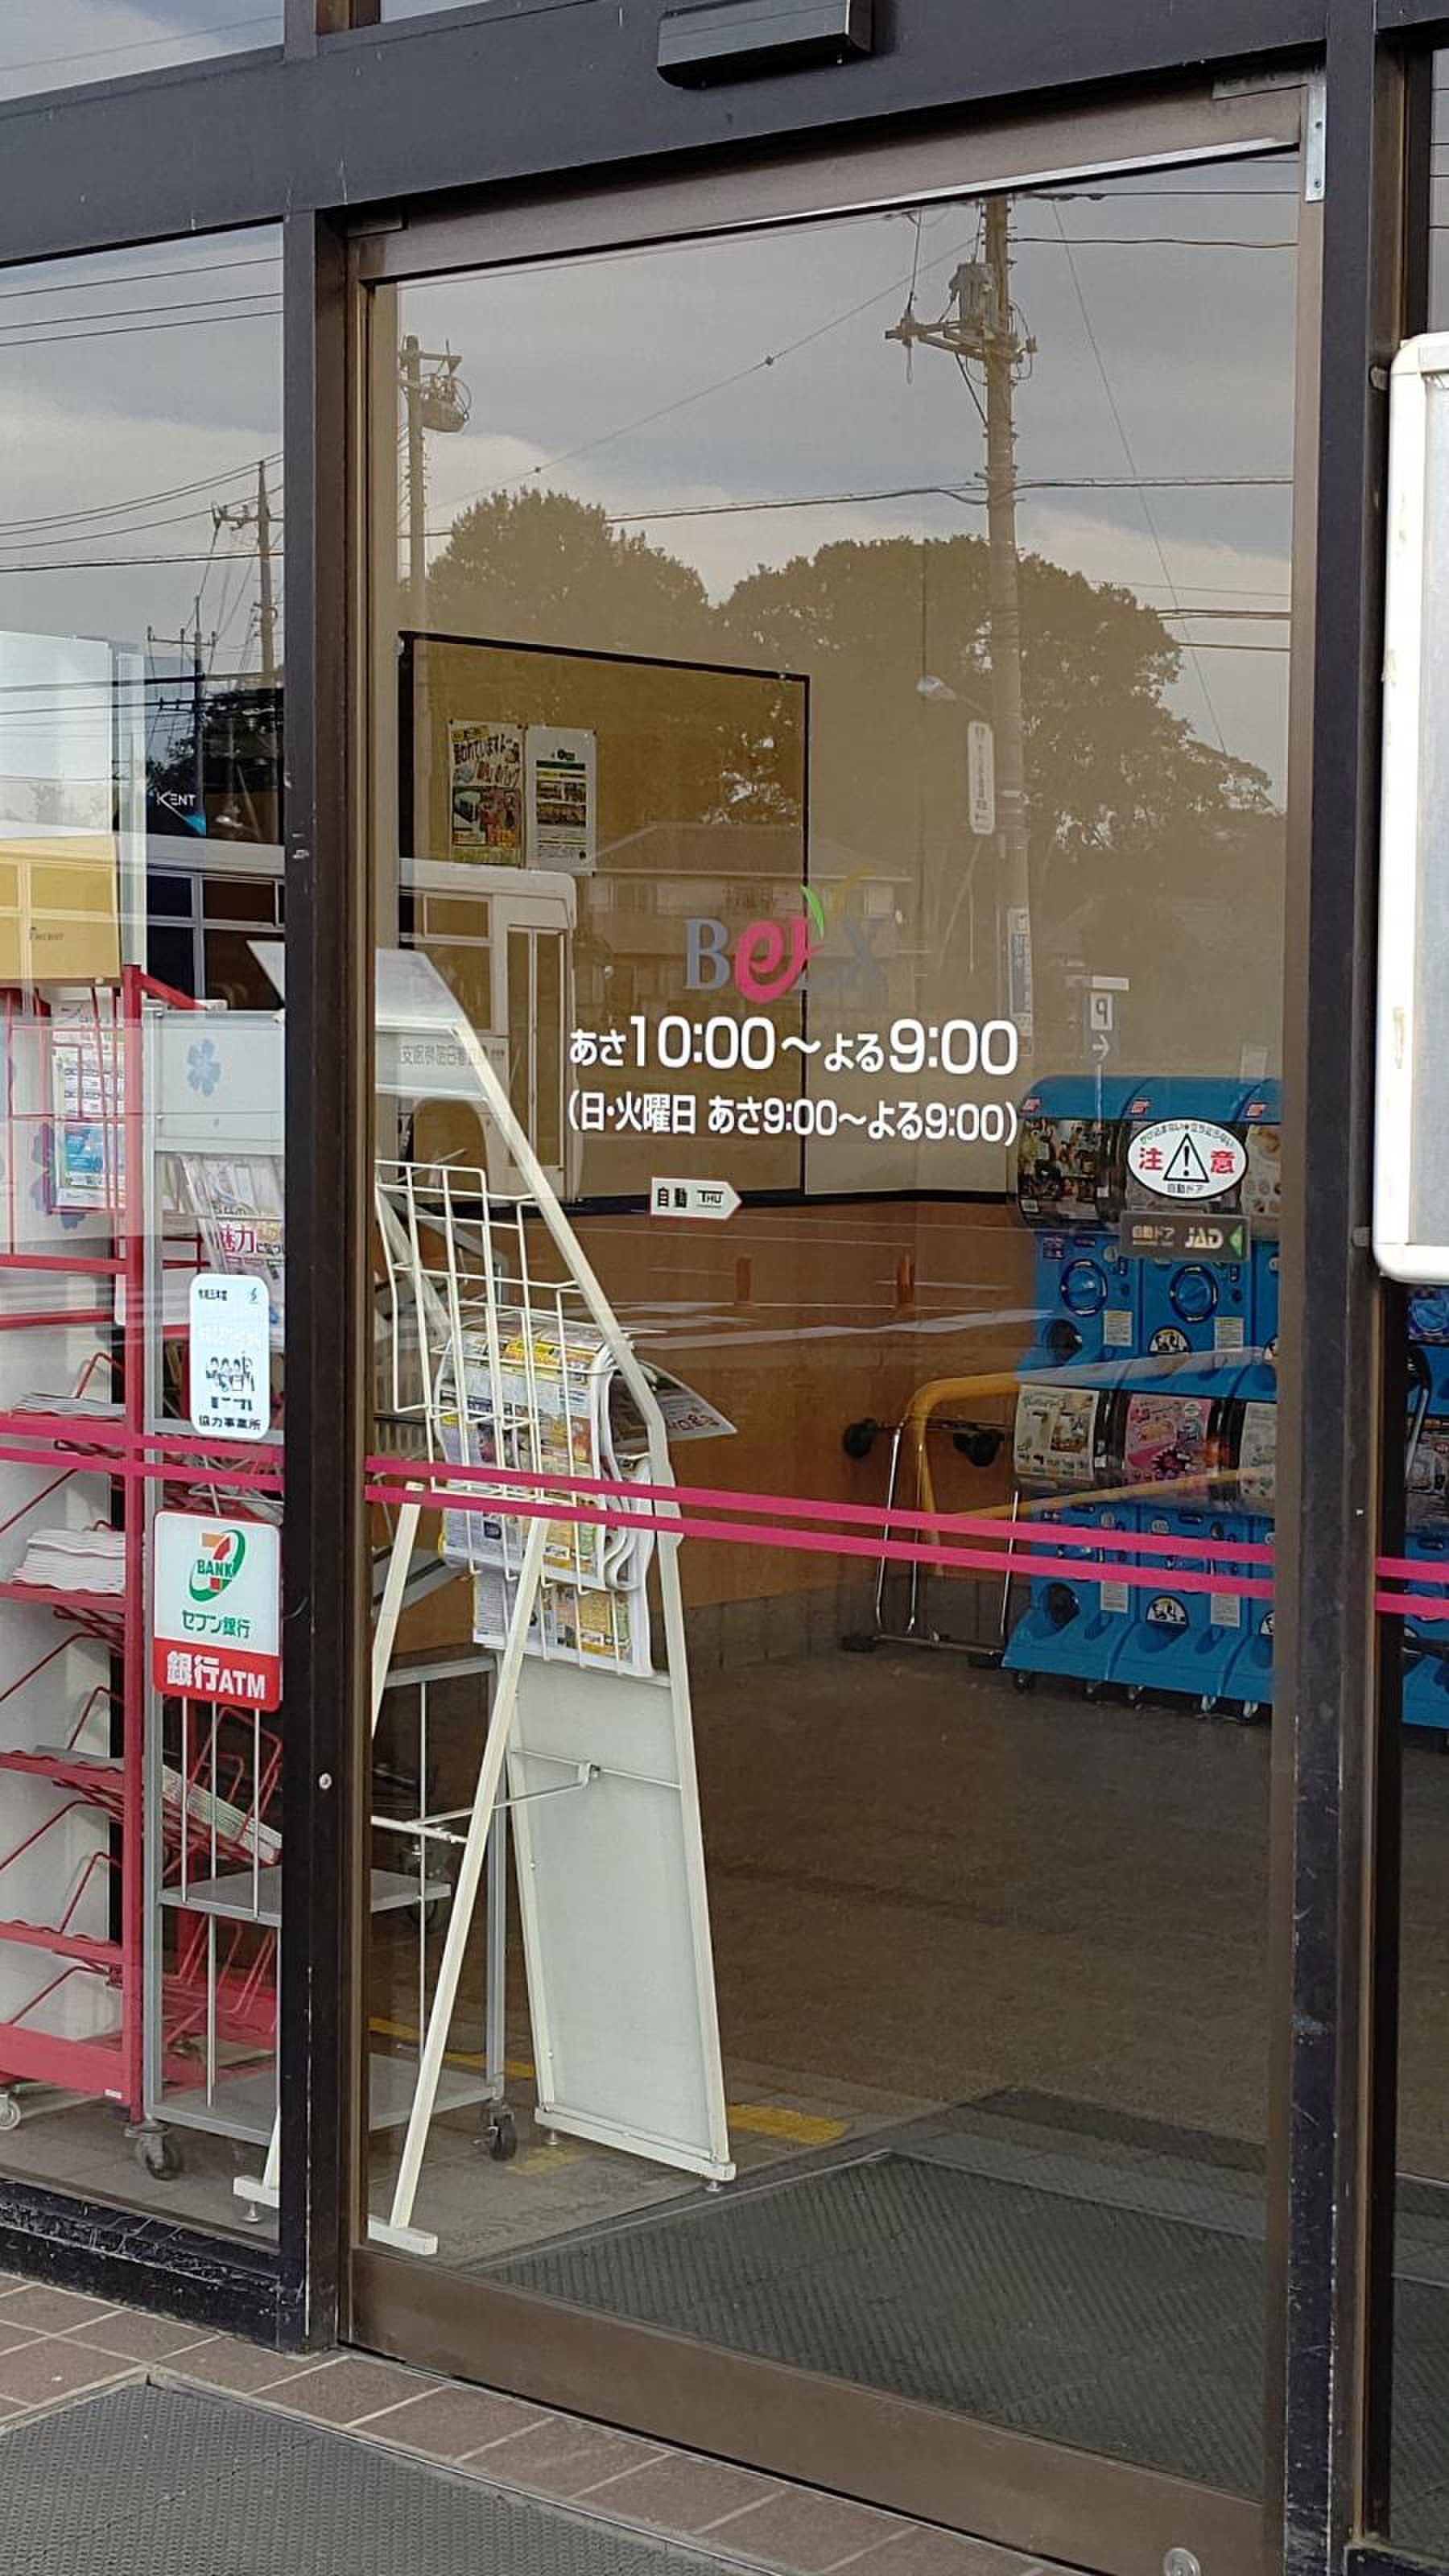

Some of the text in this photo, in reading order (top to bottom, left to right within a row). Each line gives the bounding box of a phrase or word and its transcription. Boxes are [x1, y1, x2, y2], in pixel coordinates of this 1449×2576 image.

[156, 791, 196, 807] KENT
[1139, 1147, 1236, 1174] 注 意
[657, 1187, 687, 1208] 自動
[1166, 1183, 1205, 1195] 自動ドア
[198, 1414, 262, 1430] 協力事業所
[196, 1558, 234, 1578] BANK
[167, 1650, 266, 1700] 銀行ATM
